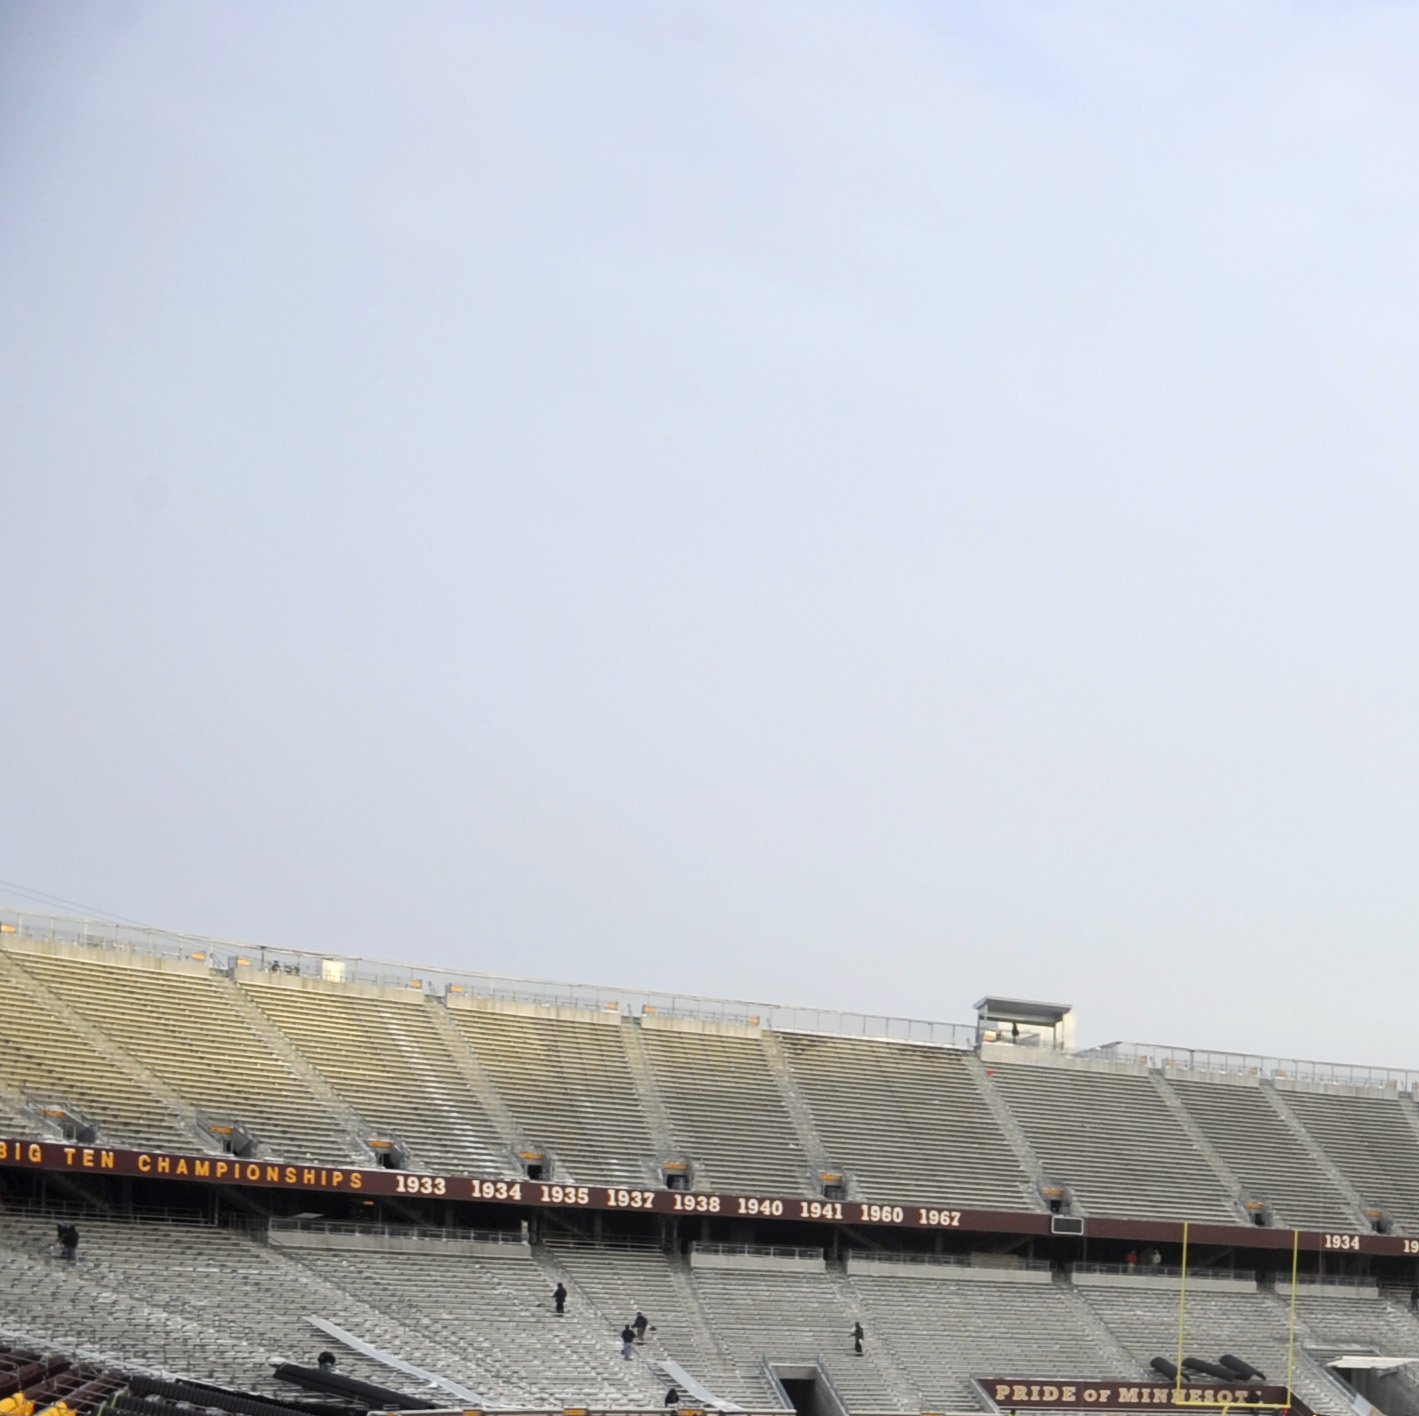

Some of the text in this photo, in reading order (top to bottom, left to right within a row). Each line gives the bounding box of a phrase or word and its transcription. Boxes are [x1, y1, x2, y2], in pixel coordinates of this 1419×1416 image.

[0, 1141, 363, 1189] BIG TEN CHAMPIONSHIPS
[396, 1175, 961, 1226] 1933 1934 1935 1937 1938 1940 1941 1960 1967
[1325, 1234, 1360, 1250] 1934
[995, 1385, 1263, 1404] PRIDE OF MINNESOT
